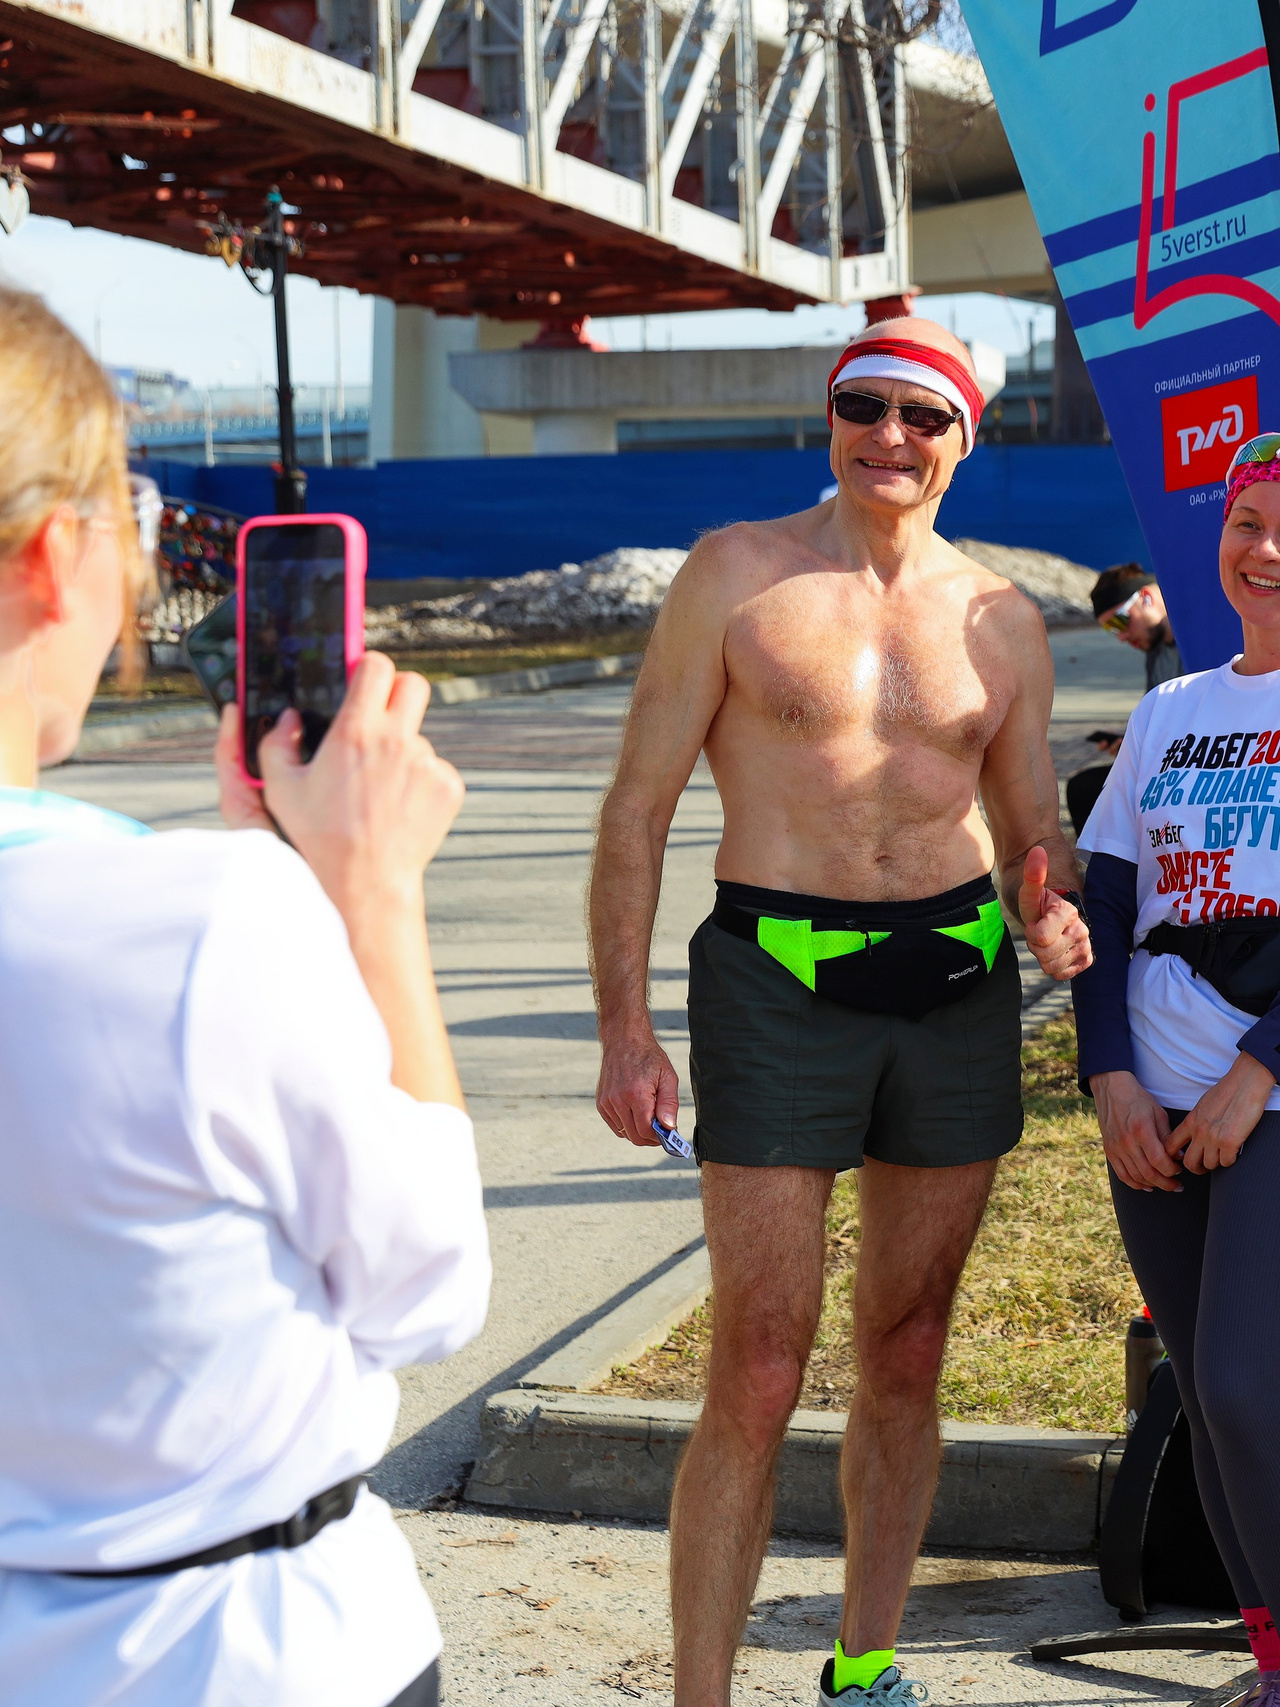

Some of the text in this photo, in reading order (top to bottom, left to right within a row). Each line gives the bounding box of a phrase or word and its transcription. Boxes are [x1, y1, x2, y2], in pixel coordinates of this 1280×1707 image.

[1160, 214, 1247, 262] 5verst.ru
[1154, 355, 1261, 394] ОФИЦИАЛЬНЫЙ ПАРТНЕР
[1189, 488, 1227, 506] ОАО «РЖ
[1139, 770, 1189, 813] 45%
